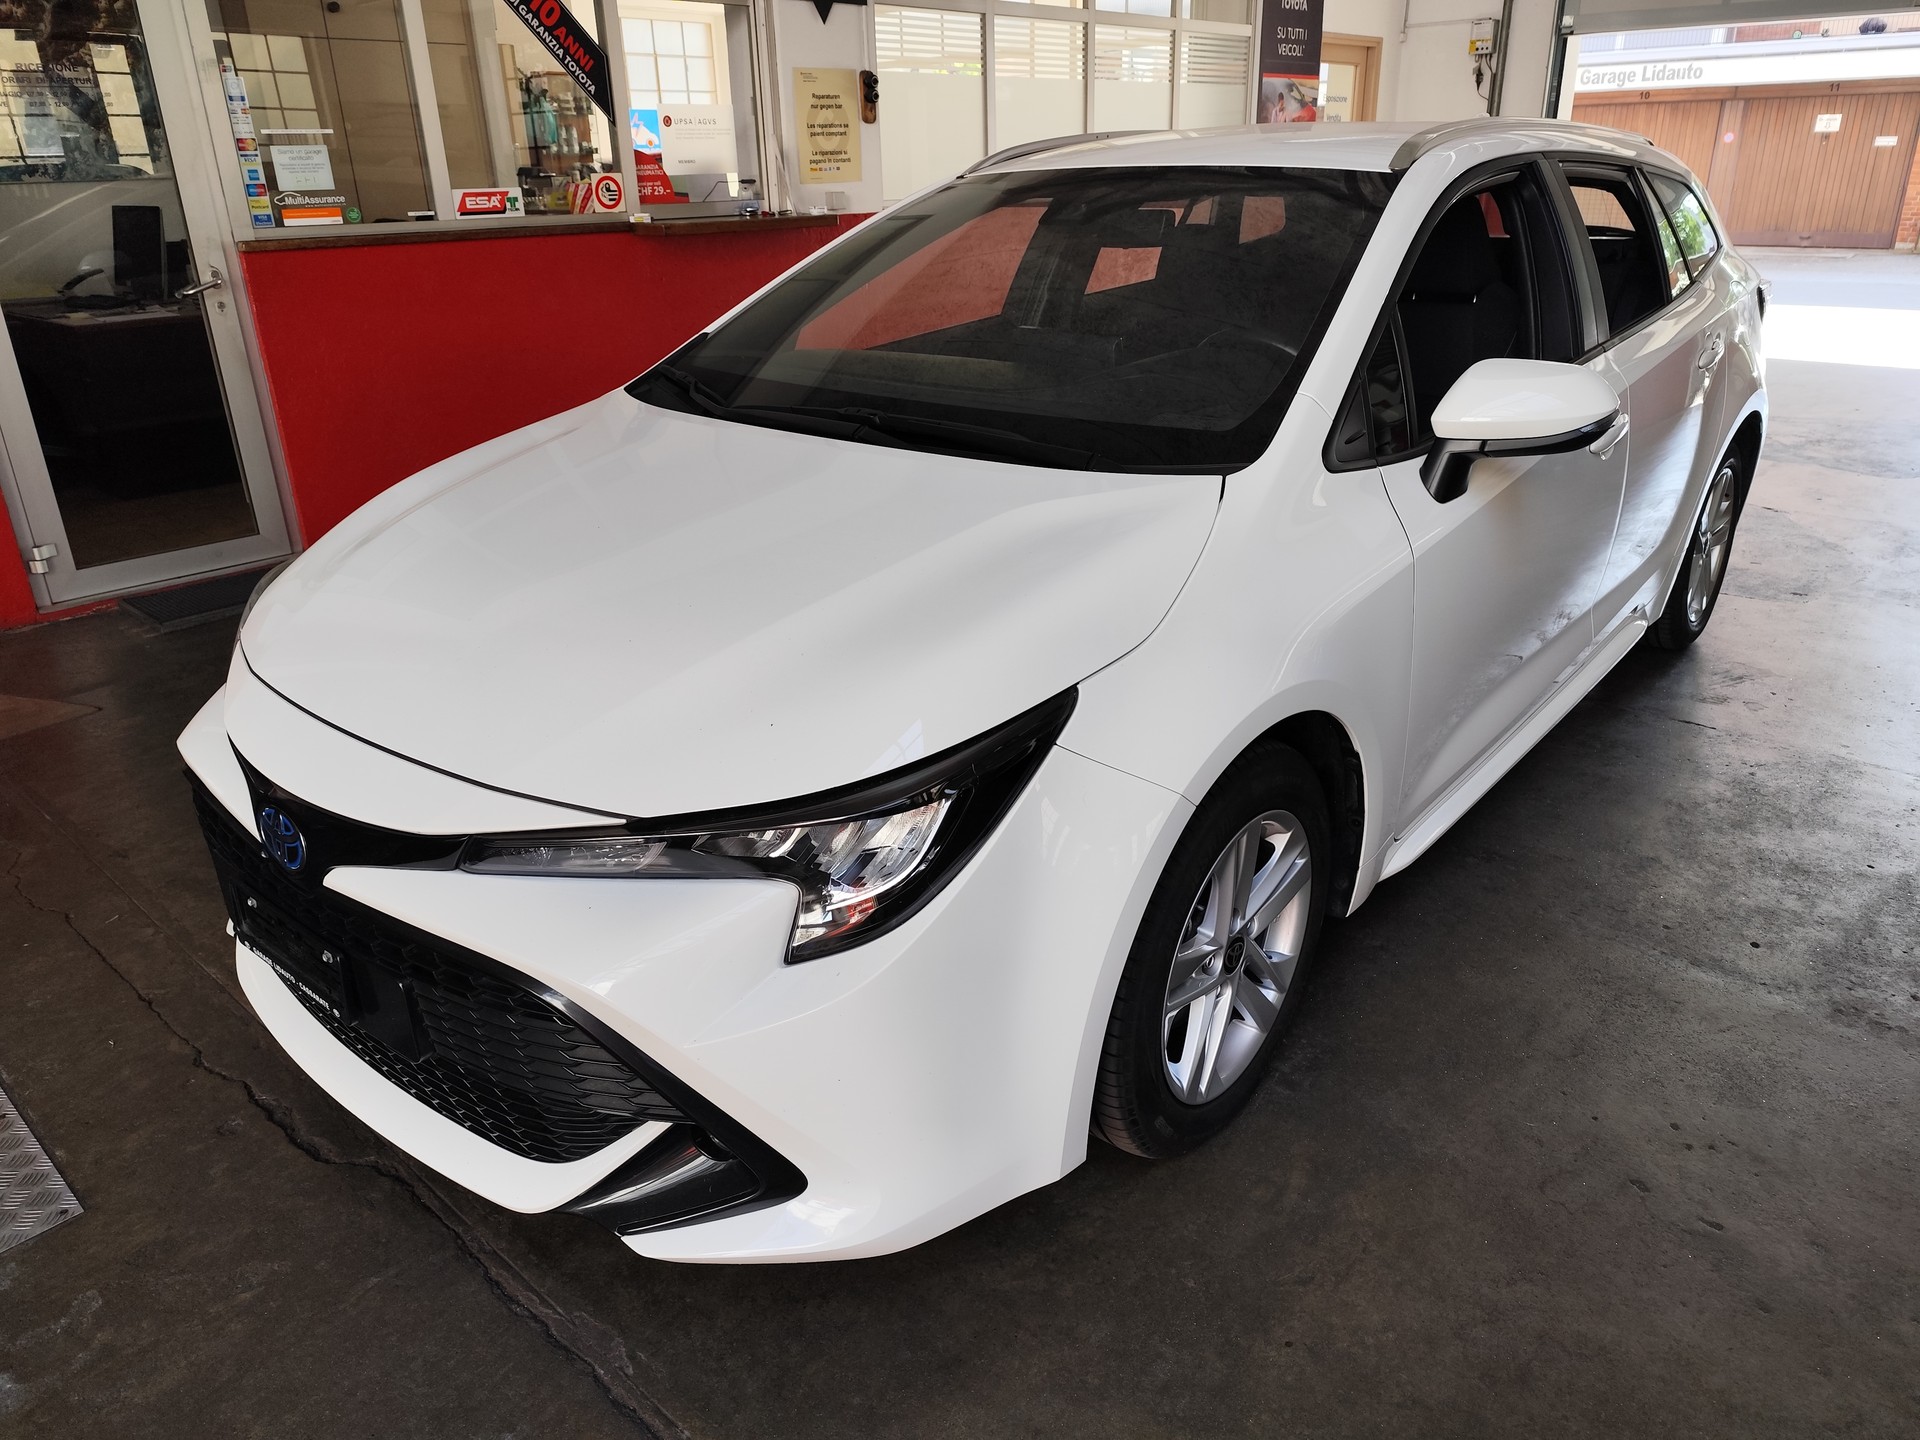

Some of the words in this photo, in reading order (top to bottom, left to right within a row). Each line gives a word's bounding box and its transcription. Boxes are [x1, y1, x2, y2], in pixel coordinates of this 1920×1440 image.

[1281, 0, 1308, 11] TOYOTA
[1277, 26, 1287, 39] SU
[1287, 27, 1304, 40] TUTTI
[519, 5, 564, 59] GARANZIA
[564, 55, 596, 95] TOYOTA
[553, 26, 594, 72] ANNI
[1580, 69, 1637, 87] Garage
[1641, 63, 1704, 82] Lidauto
[1830, 83, 1841, 92] 11
[1639, 91, 1651, 100] 10
[284, 195, 346, 205] MultiAssurance
